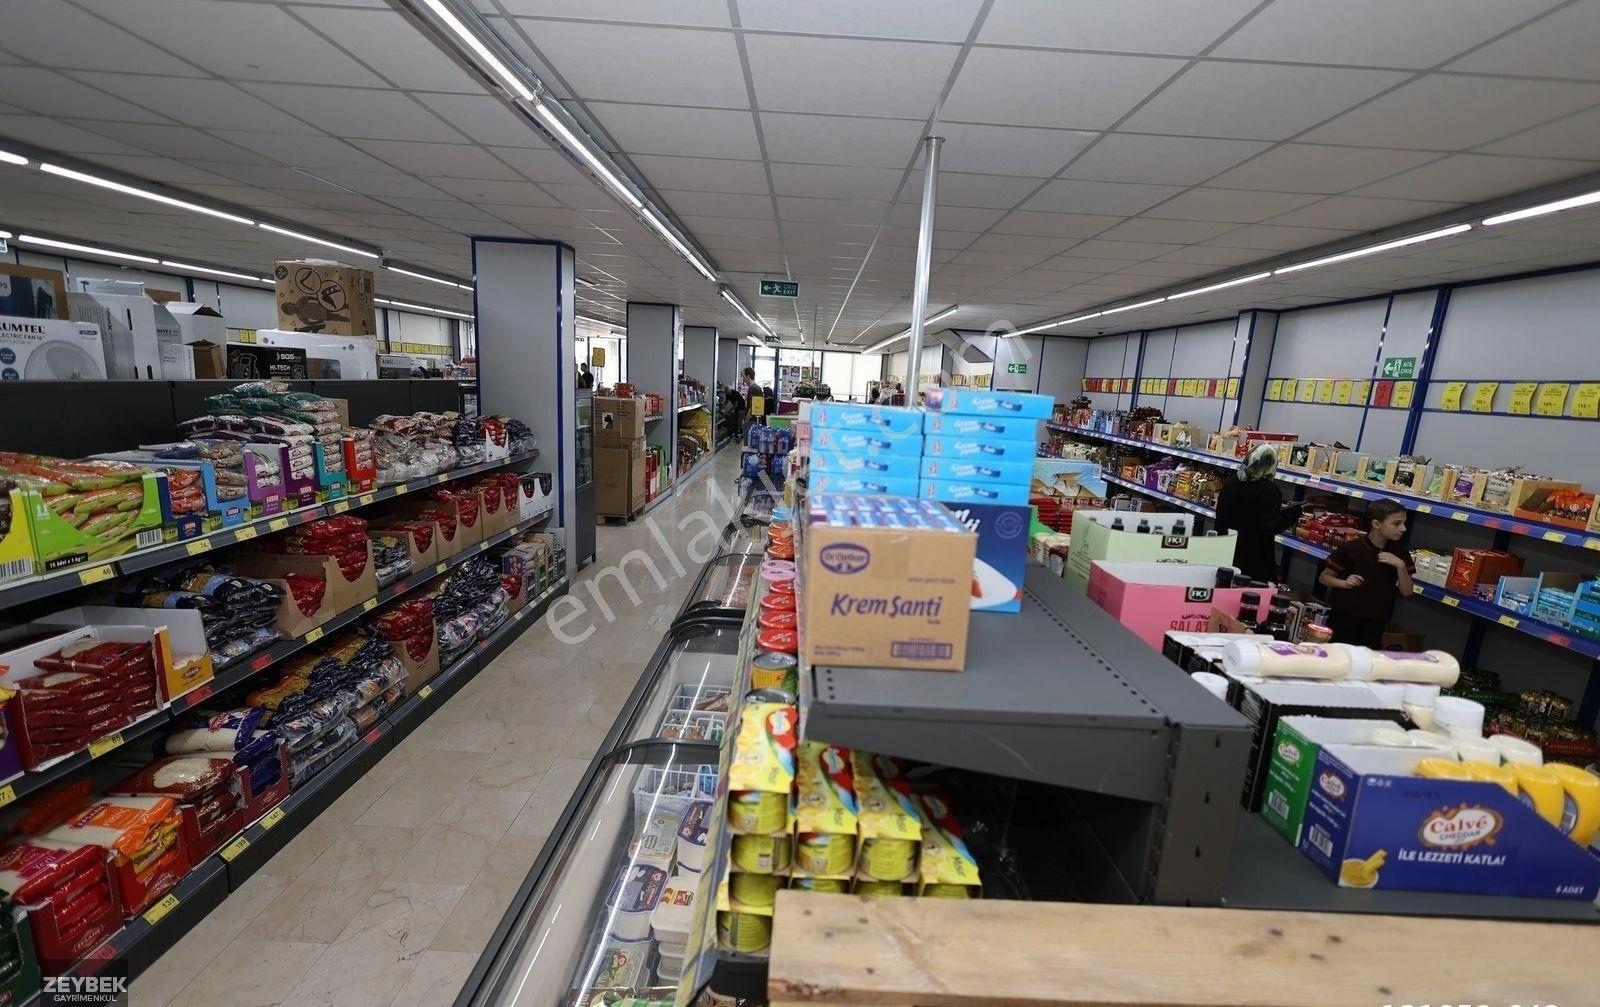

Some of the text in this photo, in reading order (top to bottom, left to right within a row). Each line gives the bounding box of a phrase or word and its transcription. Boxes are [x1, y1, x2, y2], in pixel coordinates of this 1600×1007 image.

[831, 593, 943, 618] Krem Şanti
[1430, 814, 1489, 834] Calvé
[1398, 848, 1416, 862] İLE
[1464, 854, 1507, 866] KATLA!
[161, 895, 176, 910] 135
